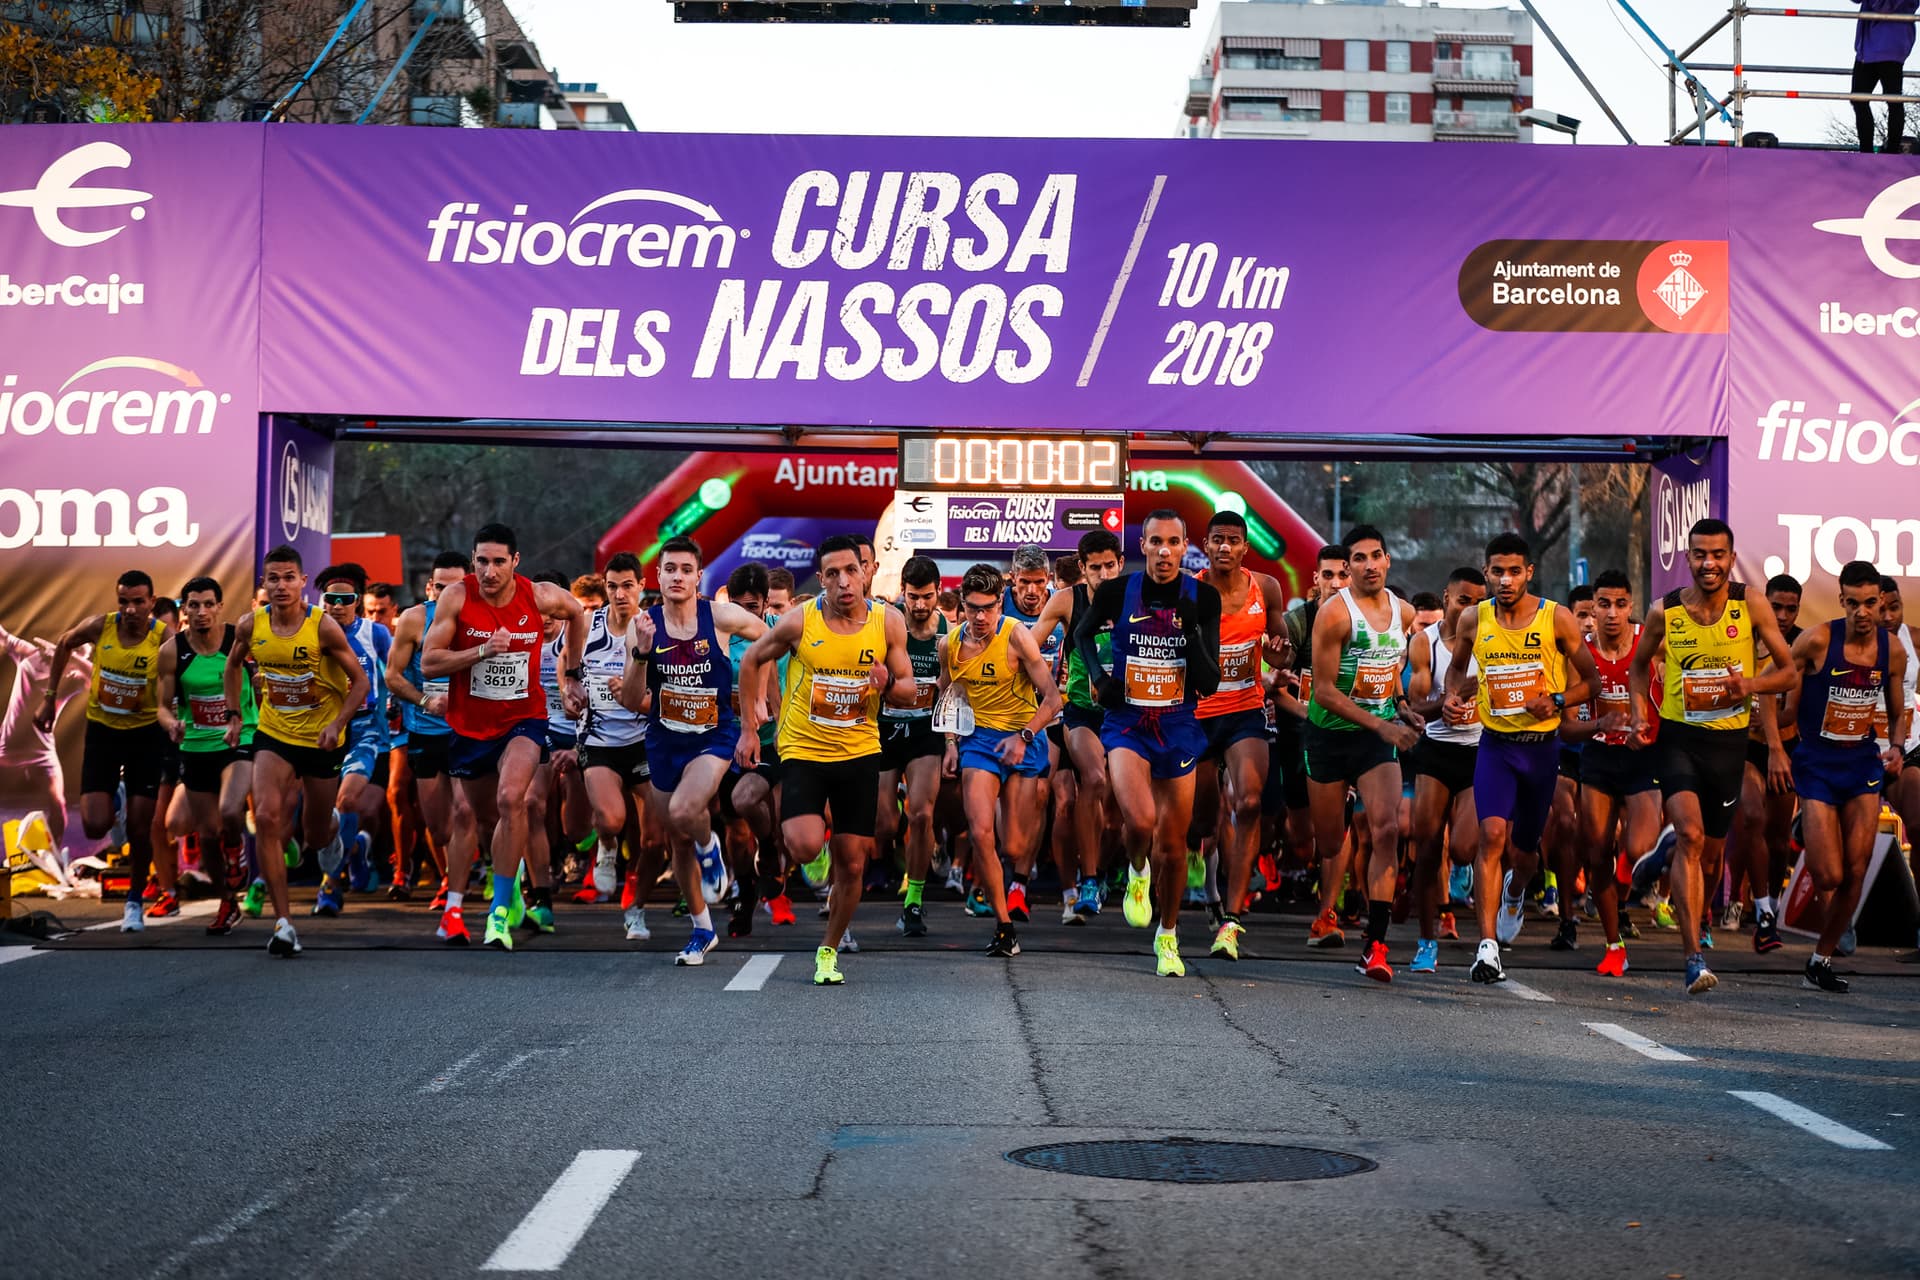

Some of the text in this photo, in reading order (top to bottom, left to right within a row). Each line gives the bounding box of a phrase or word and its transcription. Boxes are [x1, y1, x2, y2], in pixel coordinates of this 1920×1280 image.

[771, 171, 1077, 272] CURSA
[1158, 241, 1290, 309] 10 Km
[1493, 261, 1621, 282] Ajuntament de
[1492, 283, 1621, 306] Barcelona
[1819, 302, 1920, 338] iberC
[520, 279, 1064, 384] DELS NASSOS
[1148, 320, 1274, 386] 2018
[933, 438, 1117, 486] 00:00:02
[948, 498, 1055, 520] fisiocrem CURSA
[964, 520, 1053, 543] DELS NASSOS
[1129, 633, 1187, 647] FUNDACIÓ
[1524, 632, 1542, 647] LS
[294, 646, 307, 660] LS
[859, 649, 874, 665] LS
[1138, 646, 1177, 660] BARÇA
[1485, 652, 1541, 660] LASANSI.COM
[485, 665, 516, 674] JORDI
[656, 659, 712, 675] FUNDACIÓ
[982, 663, 996, 677] LS
[1223, 667, 1238, 677] 16
[484, 675, 516, 687] 3619
[1134, 672, 1176, 684] EL MEHDI
[1147, 684, 1163, 696] 41
[1373, 684, 1386, 695] 20
[1508, 690, 1525, 703] 38
[1829, 686, 1879, 699] FUNDACIÓ
[669, 698, 710, 710] ANTONIO
[825, 691, 860, 705] SAMIR
[1711, 695, 1719, 706] 7
[682, 708, 697, 720] 48
[835, 704, 850, 715] 24
